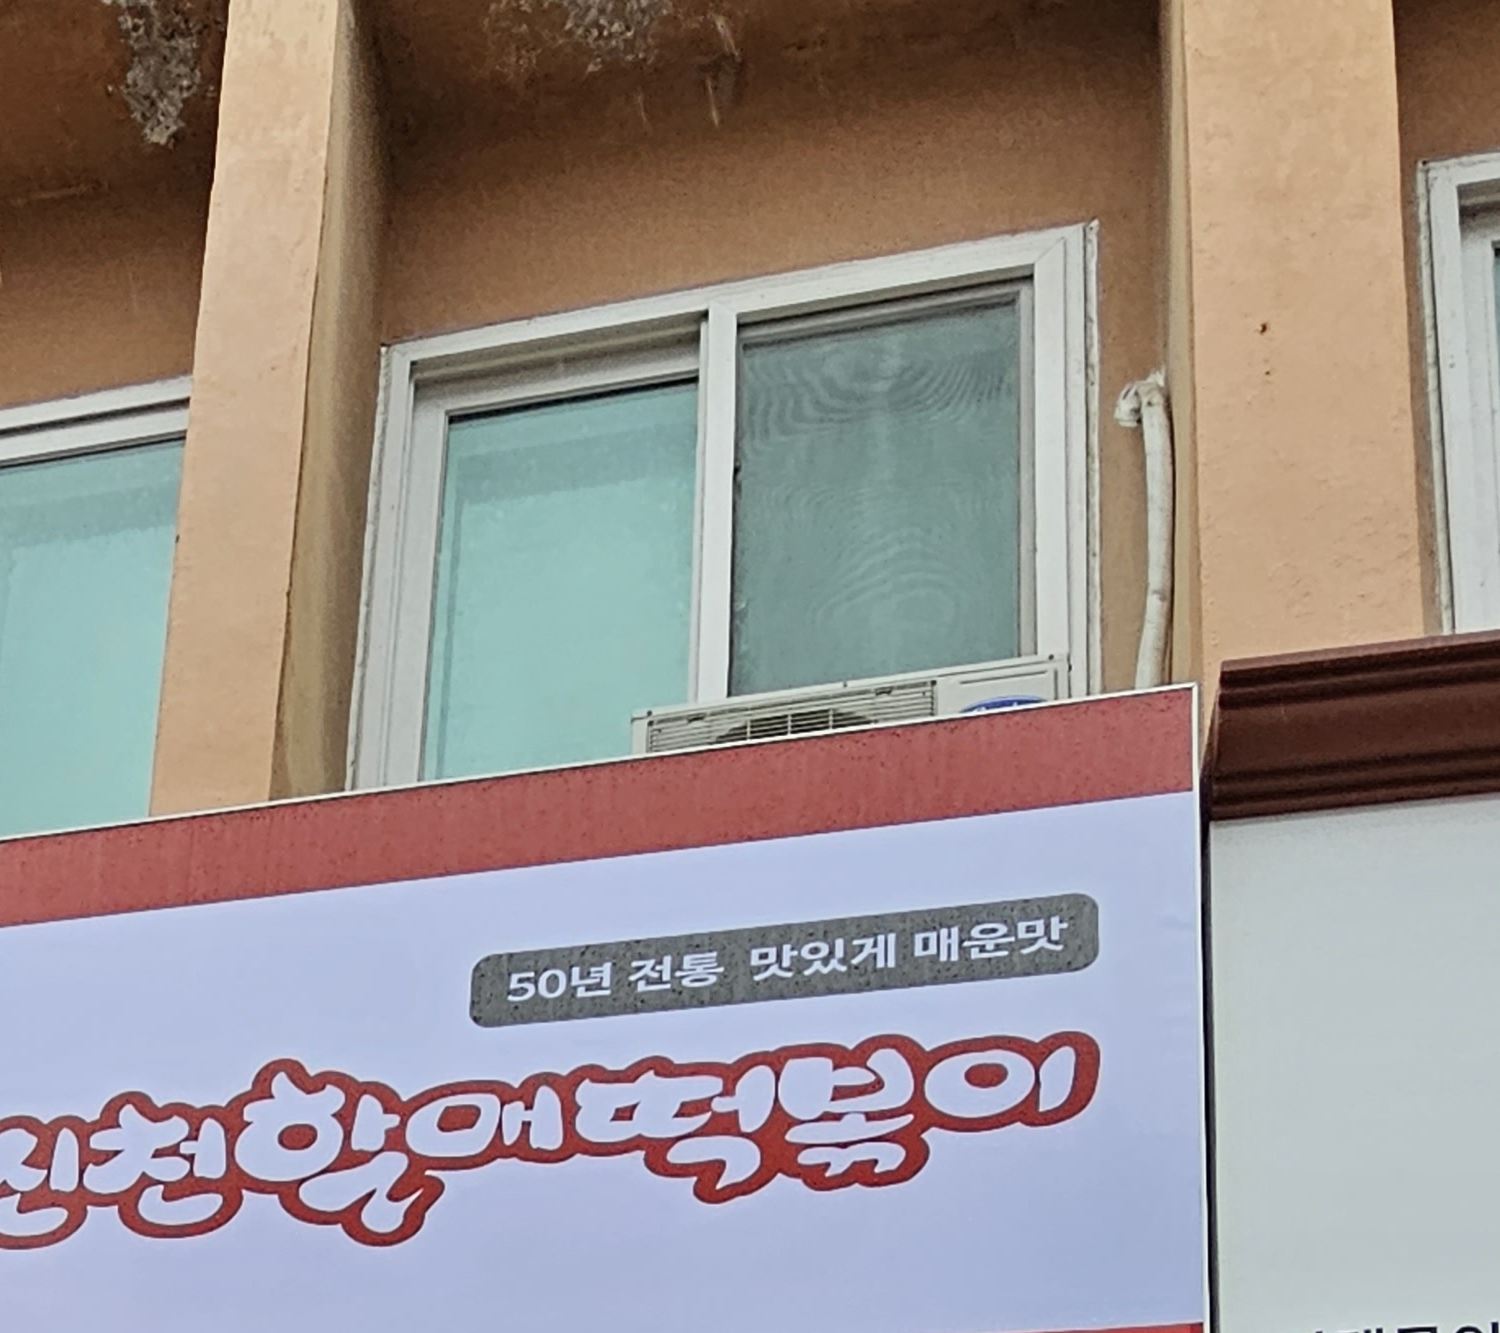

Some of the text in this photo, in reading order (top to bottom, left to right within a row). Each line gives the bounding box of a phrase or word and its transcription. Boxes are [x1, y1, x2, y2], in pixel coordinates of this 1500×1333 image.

[505, 915, 1069, 1005] 50년 전통 맛있게 매운맛
